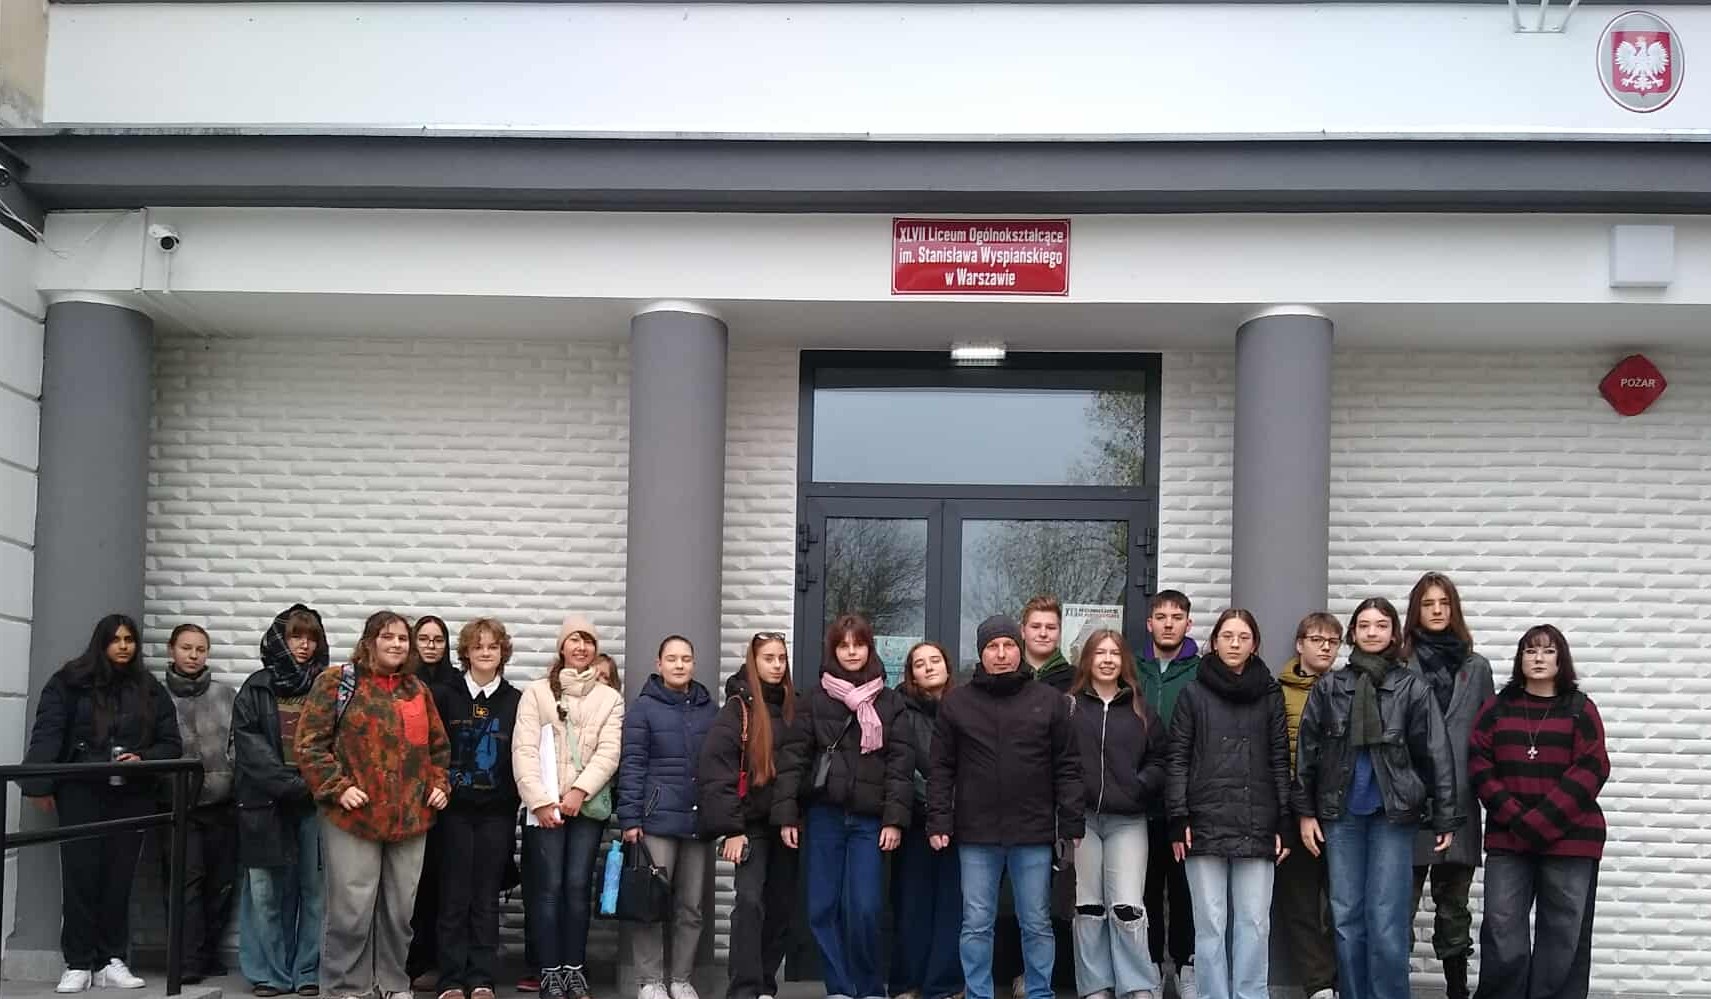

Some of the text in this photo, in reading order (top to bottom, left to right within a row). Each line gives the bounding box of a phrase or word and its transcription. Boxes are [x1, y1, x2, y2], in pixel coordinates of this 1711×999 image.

[899, 226, 1064, 246] XLVII Liceum Ogólnokształcące
[899, 246, 1063, 268] im. Stanisława Wyspiańskiego
[945, 267, 1016, 286] w Warszawie
[1620, 377, 1656, 388] POŻAR
